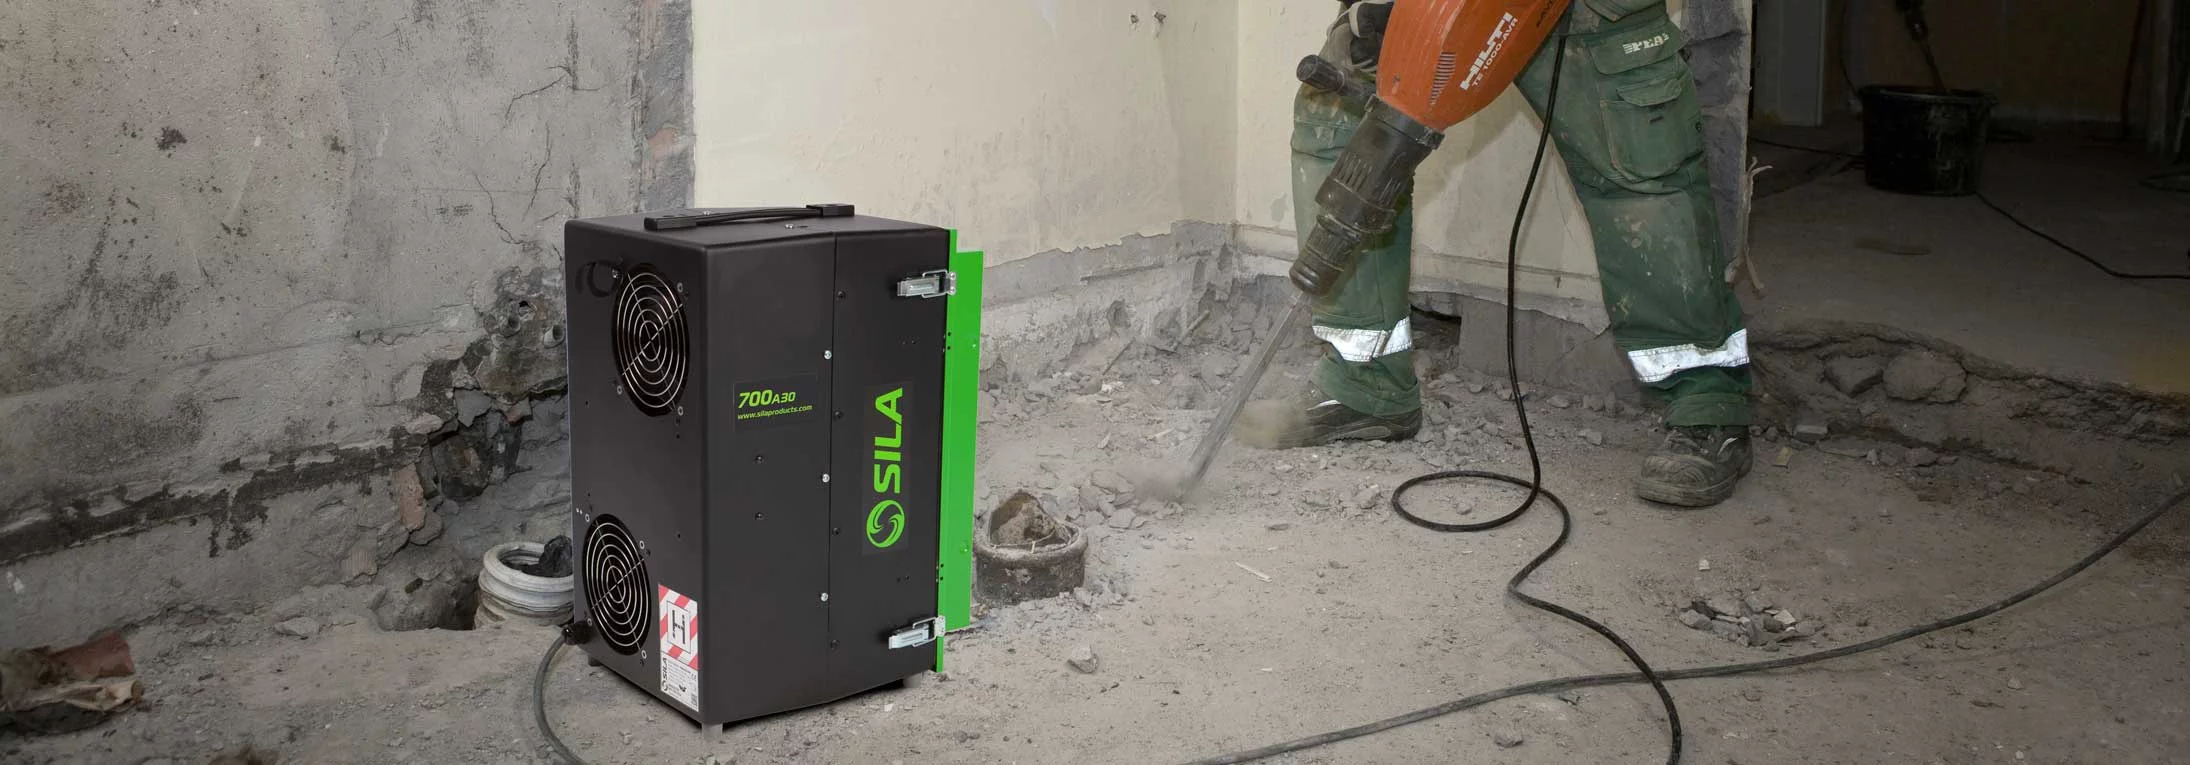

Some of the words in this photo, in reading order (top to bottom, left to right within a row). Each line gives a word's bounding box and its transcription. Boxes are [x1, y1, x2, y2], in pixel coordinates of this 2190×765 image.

[1460, 12, 1513, 90] HILTI
[1472, 72, 1484, 87] TE
[1483, 17, 1518, 70] 1000-AVR
[737, 405, 813, 420] www.silaproducts.com
[874, 387, 903, 494] SILA
